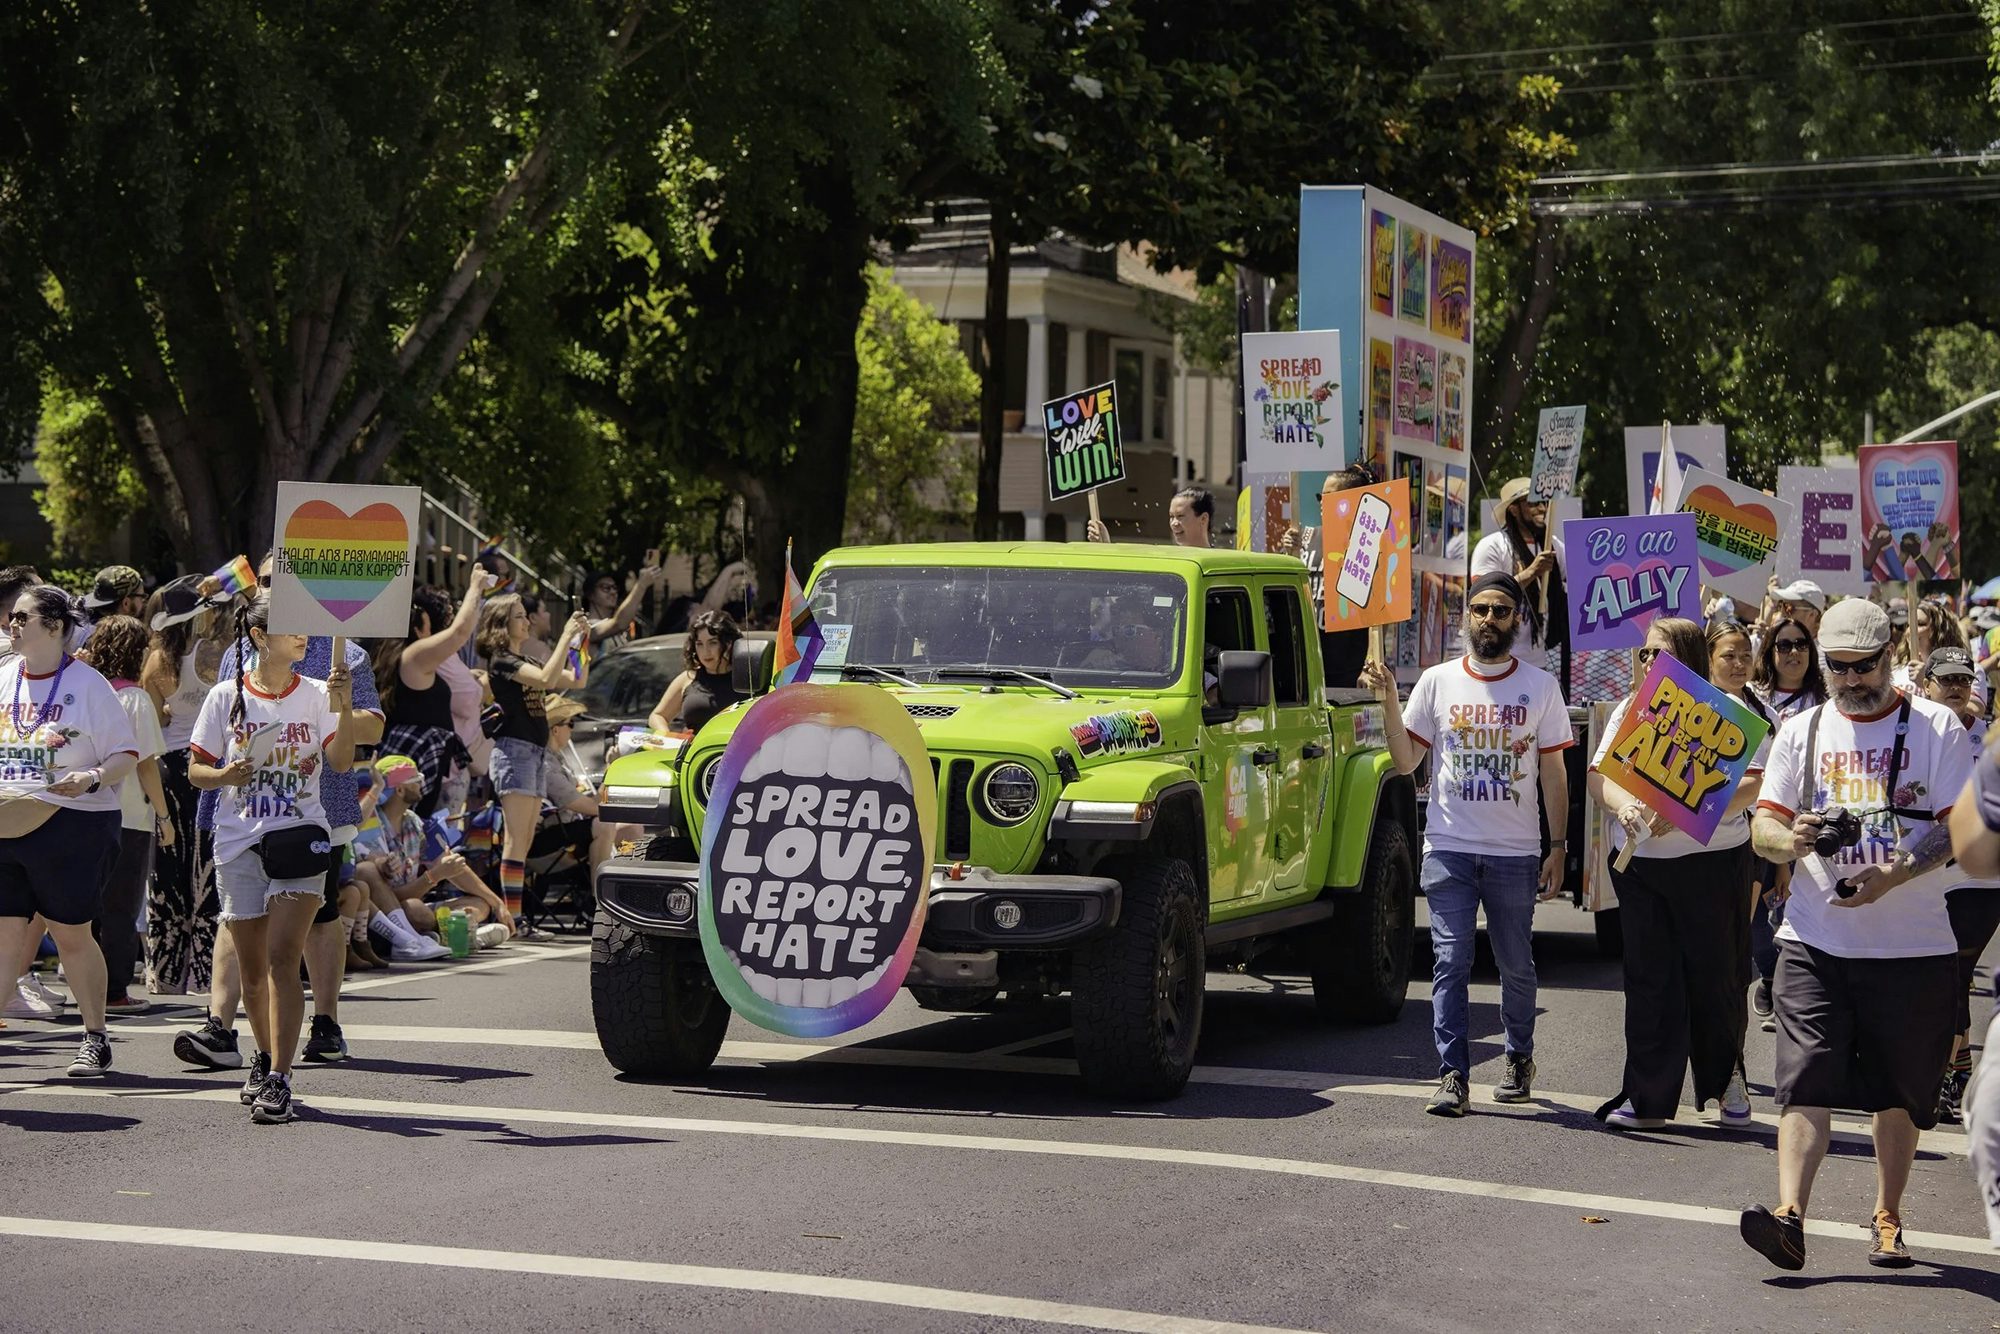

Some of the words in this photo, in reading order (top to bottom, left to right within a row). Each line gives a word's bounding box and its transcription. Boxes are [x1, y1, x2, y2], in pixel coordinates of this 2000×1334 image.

[1260, 358, 1321, 379] SPREAD
[1272, 380, 1311, 400] LOVE
[1047, 388, 1113, 430] LOVE
[1263, 402, 1323, 424] REPORT
[1274, 424, 1315, 444] HATE
[1896, 468, 1941, 486] AMOR
[1587, 528, 1626, 560] Be
[1639, 529, 1677, 554] an
[1696, 526, 1722, 547] 오를
[1723, 520, 1778, 553] 퍼뜨리고
[1801, 492, 1853, 571] E
[321, 562, 336, 575] NA
[1580, 565, 1690, 627] ALLY
[1449, 704, 1527, 726] SPREAD
[1649, 675, 1747, 760] PROUD
[233, 722, 311, 744] SPAD
[1462, 726, 1513, 751] LOVE
[1652, 713, 1671, 736] TO
[1672, 728, 1693, 752] BE
[1692, 745, 1719, 769] AN
[1229, 764, 1247, 794] CA
[1452, 753, 1522, 779] REPORT
[1612, 720, 1729, 812] ALLY
[1462, 780, 1512, 801] HATE
[1834, 777, 1889, 804] LOV
[246, 796, 293, 817] HATE
[732, 784, 910, 833] SPREAD
[721, 827, 912, 888] LOVE,
[720, 877, 906, 923] REPORT
[740, 922, 878, 972] HATE
